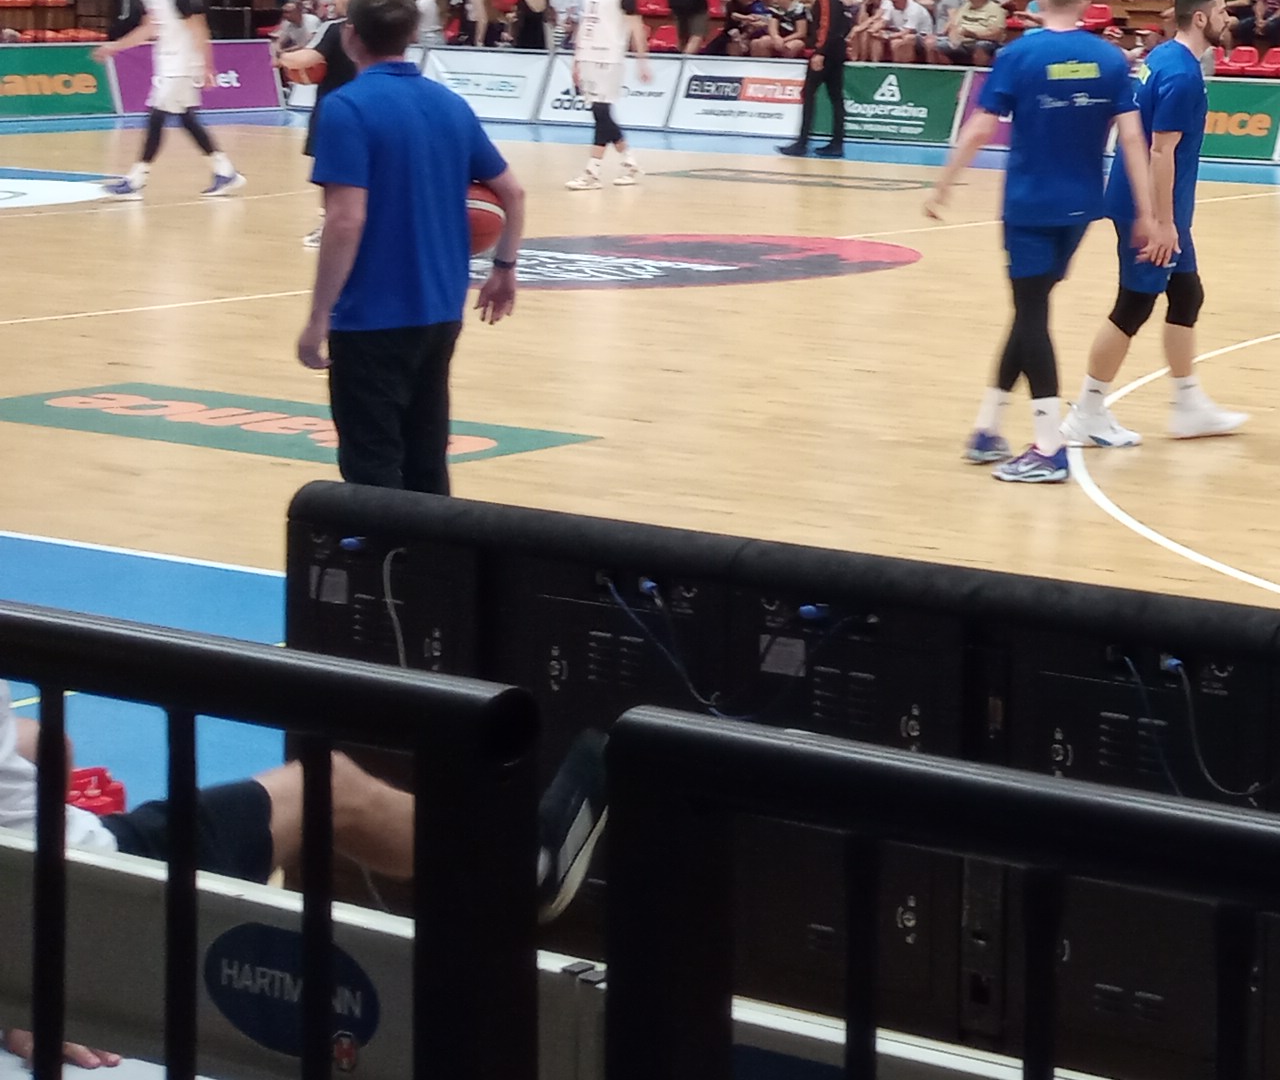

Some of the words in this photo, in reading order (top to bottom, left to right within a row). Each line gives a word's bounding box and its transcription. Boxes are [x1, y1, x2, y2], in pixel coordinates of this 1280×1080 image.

[0, 73, 98, 96] ance
[690, 80, 741, 97] ELEKTRO
[221, 958, 362, 1019] HARTMNN
